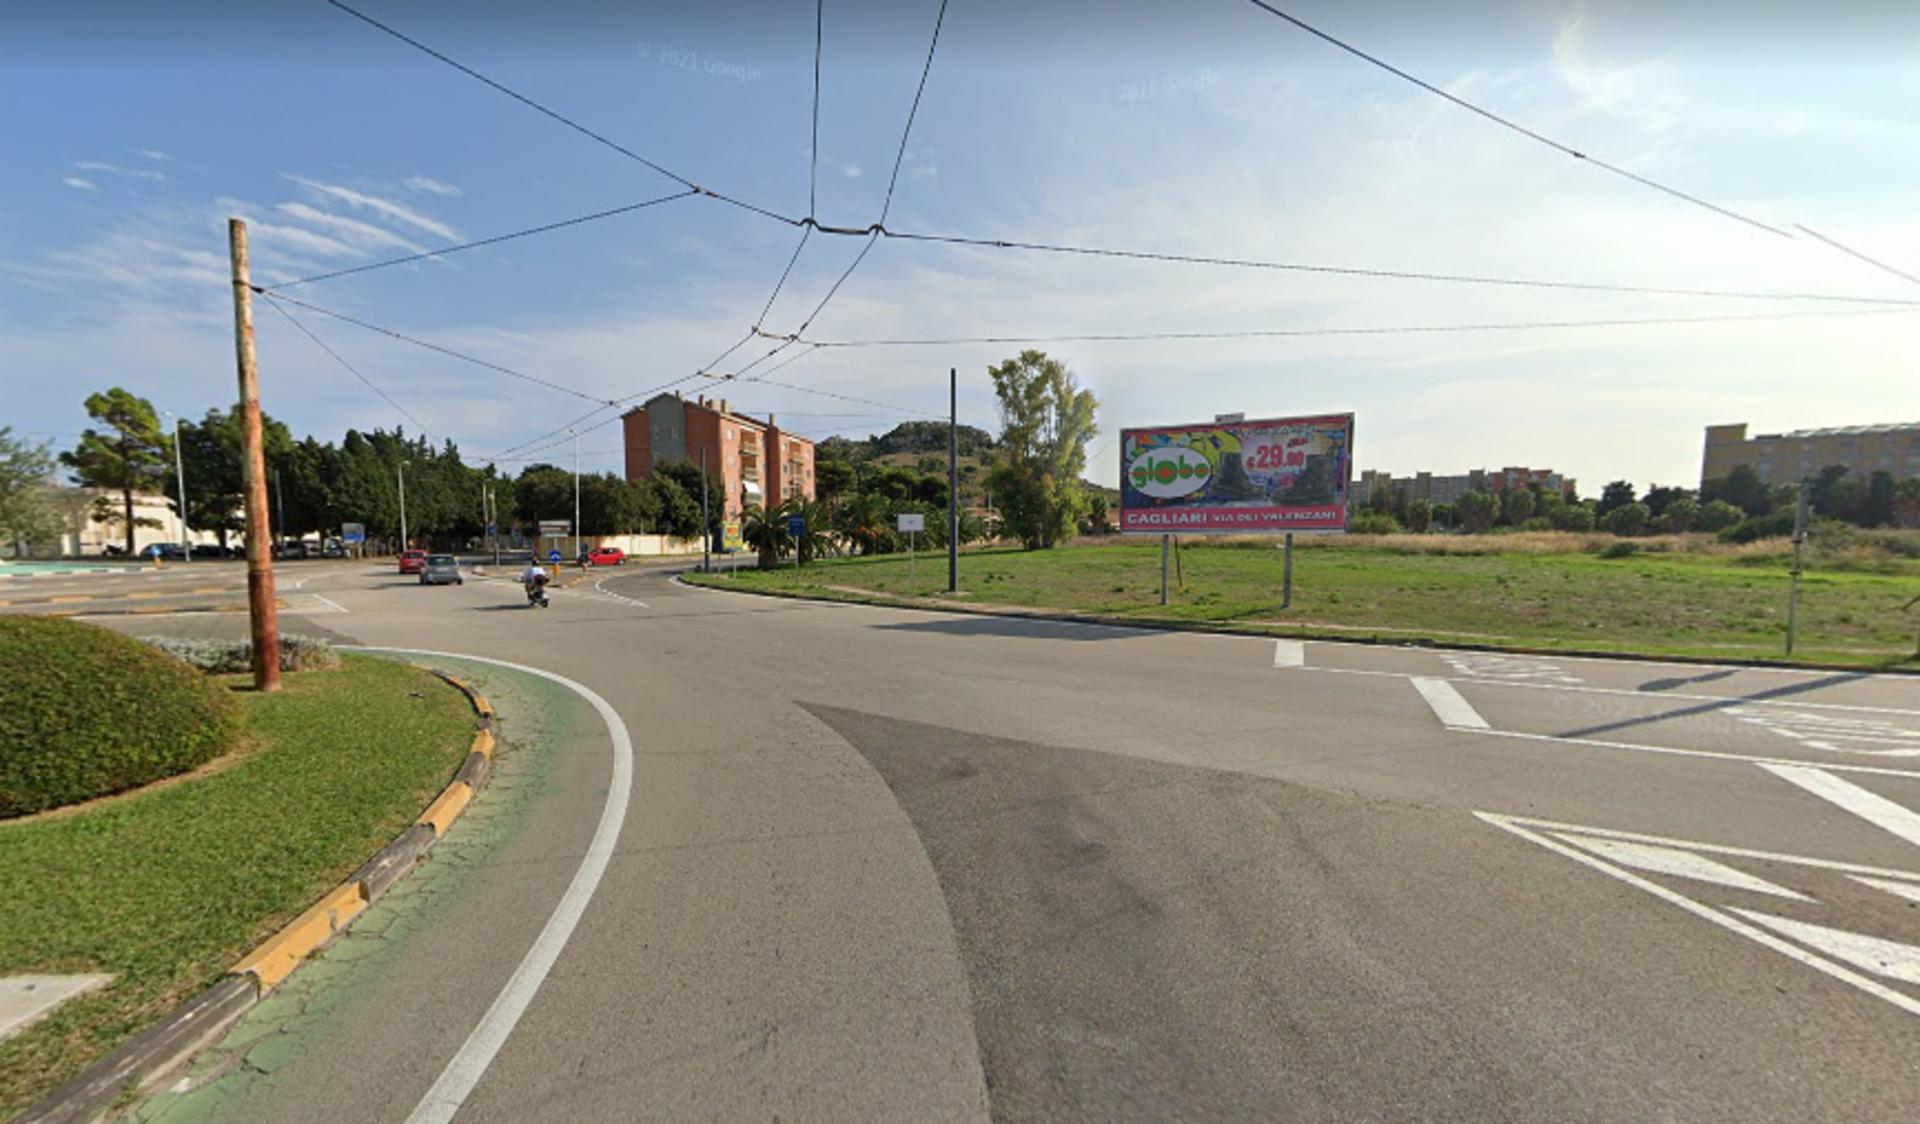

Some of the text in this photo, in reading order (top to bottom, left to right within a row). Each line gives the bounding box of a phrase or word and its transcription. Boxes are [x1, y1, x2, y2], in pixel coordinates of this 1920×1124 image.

[1131, 455, 1210, 488] globo
[1127, 513, 1207, 525] CAGLIARI
[1213, 514, 1234, 522] VIA
[1238, 514, 1258, 522] DEI
